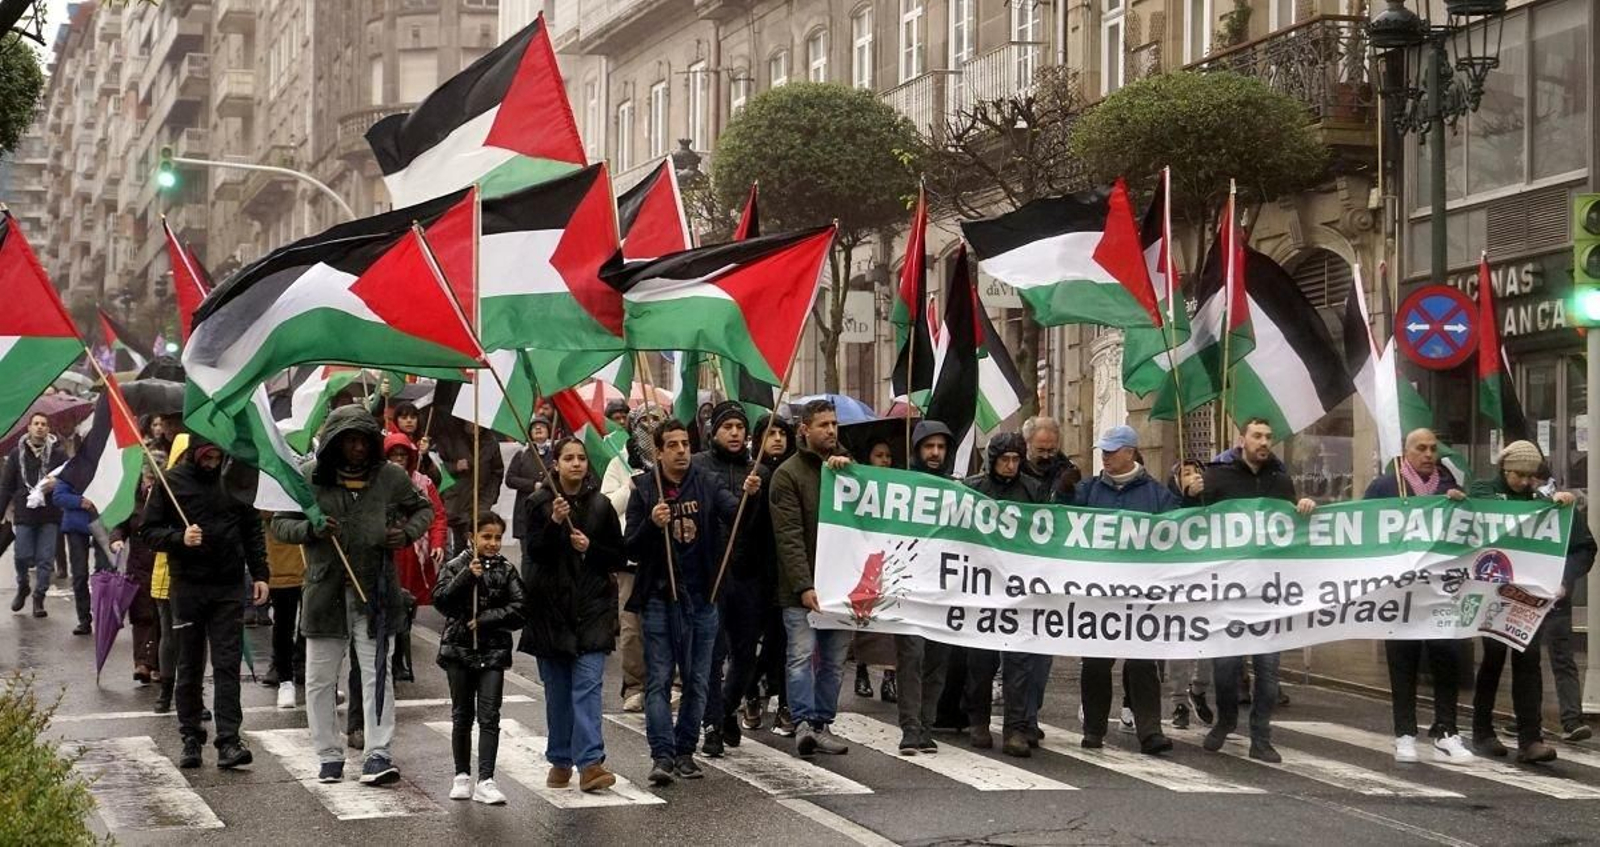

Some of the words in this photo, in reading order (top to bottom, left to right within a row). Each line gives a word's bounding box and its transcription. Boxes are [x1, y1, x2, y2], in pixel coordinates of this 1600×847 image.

[833, 474, 1022, 540] PAREMOS
[1029, 508, 1054, 544] O
[1064, 511, 1294, 551] XENOCIDIO
[1308, 511, 1362, 546] EN
[939, 551, 992, 596] Fin
[1005, 574, 1051, 598] ao
[1064, 573, 1248, 603] comercio
[1261, 572, 1304, 606] de
[947, 606, 965, 631] e
[976, 607, 1020, 635] as
[1032, 600, 1211, 643] relacións
[1505, 623, 1529, 640] VIGO
